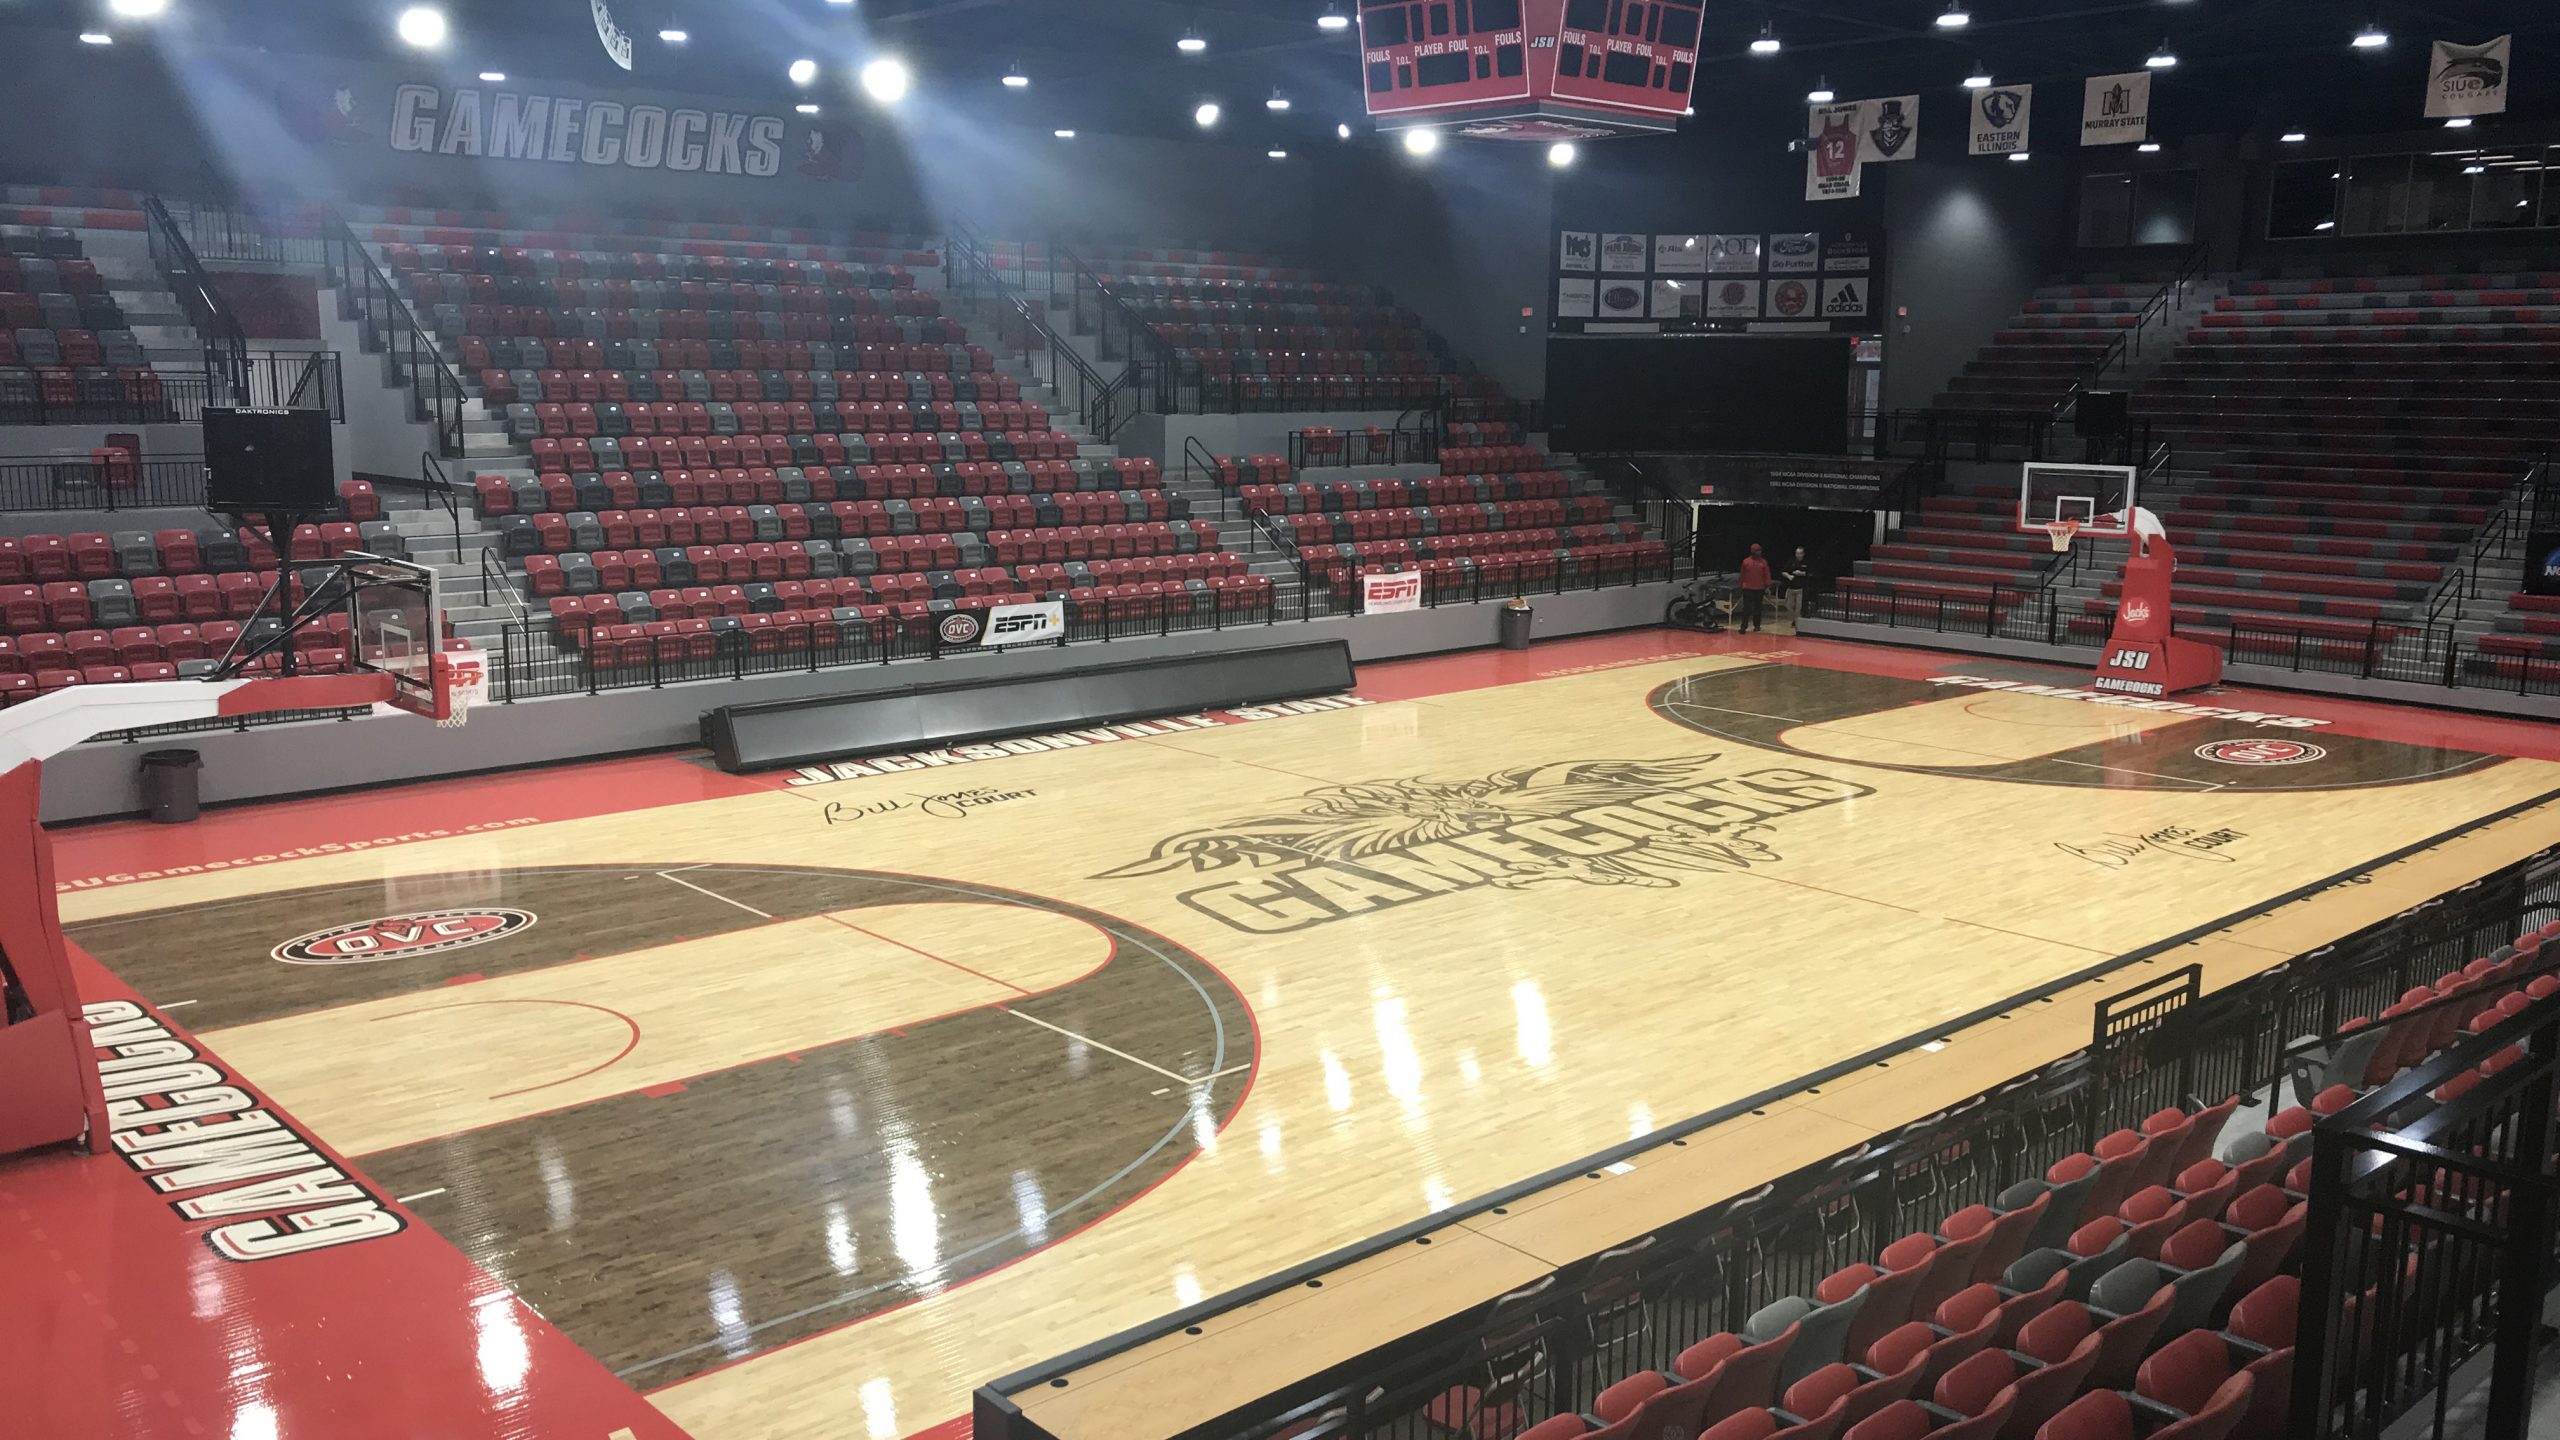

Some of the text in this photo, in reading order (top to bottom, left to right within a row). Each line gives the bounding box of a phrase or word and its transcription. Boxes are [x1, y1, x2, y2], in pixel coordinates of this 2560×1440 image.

[1414, 39, 1469, 57] PLAYER FOUL
[1494, 31, 1522, 46] FOULS
[1531, 36, 1555, 48] JSU
[1563, 31, 1586, 46] FOULS
[1607, 38, 1653, 57] PLAYER FOUL
[1366, 50, 1391, 63] FOULS
[1672, 50, 1693, 64] FOULS
[389, 83, 786, 177] GAMECOCKS
[2084, 115, 2146, 130] MURRAY STATE
[1977, 131, 2020, 142] EASTERN
[1826, 140, 1845, 160] 12
[1978, 141, 2017, 152] ILLINOIS
[1710, 237, 1758, 256] AOD
[1779, 239, 1809, 253] Ford
[1772, 260, 1814, 268] Go Further
[1826, 301, 1863, 313] adidas
[1368, 578, 1418, 600] ESPN
[948, 623, 969, 634] OVC
[2110, 649, 2149, 670] JSU
[2094, 677, 2163, 696] GAMECOCKS
[1926, 675, 2334, 729] GAMECOCKS
[785, 693, 1378, 787] JACKSONVILLE STATE
[2229, 744, 2290, 760] OVC
[956, 788, 1039, 808] COURT
[824, 800, 913, 825] Bill
[2183, 827, 2249, 850] COURT
[55, 816, 541, 892] SUGamecockSports.com
[1176, 767, 1878, 934] GAMECOCKS
[2053, 839, 2146, 870] Bill
[336, 918, 474, 953] OVC
